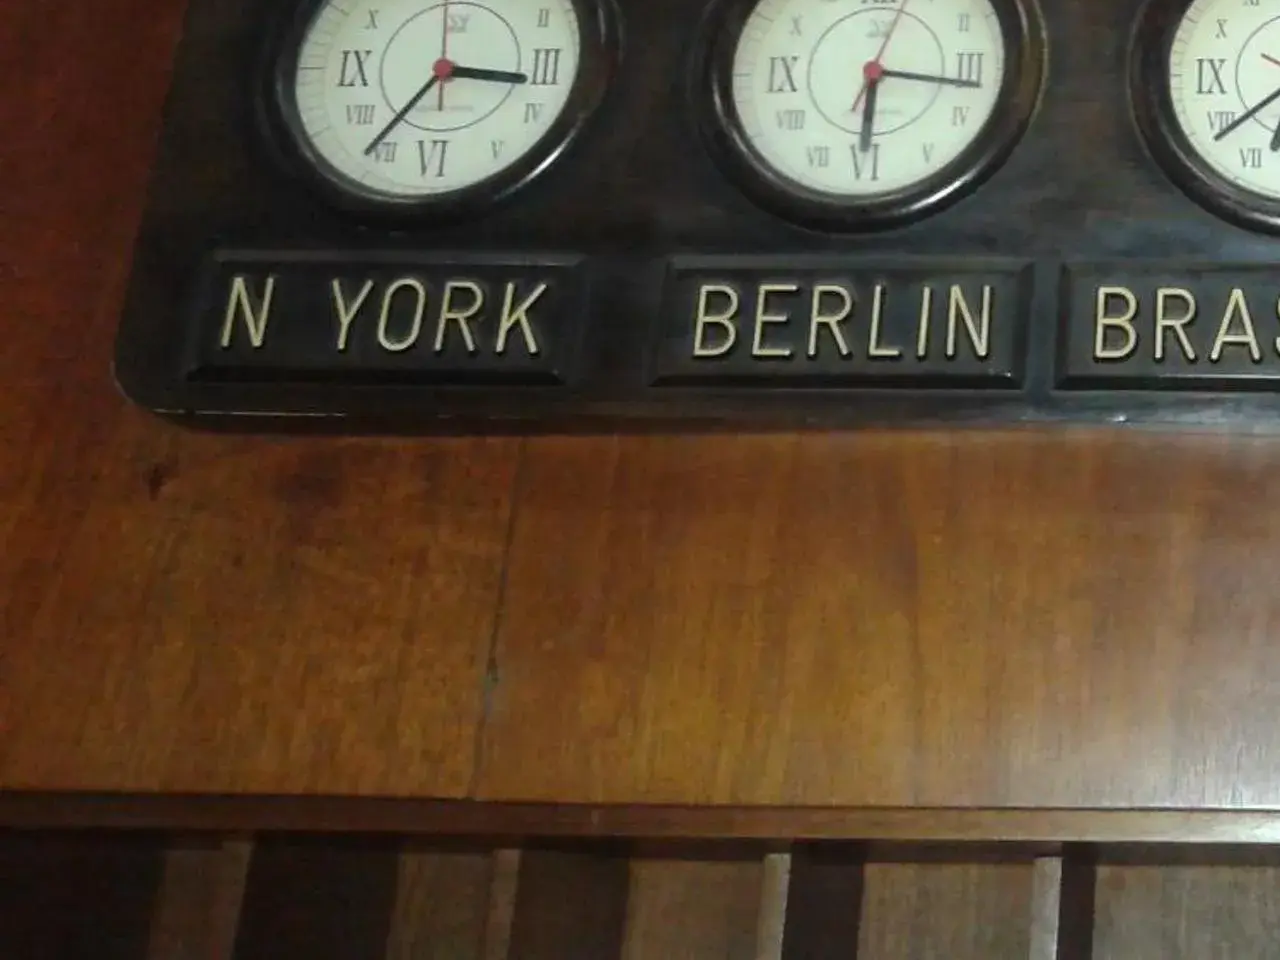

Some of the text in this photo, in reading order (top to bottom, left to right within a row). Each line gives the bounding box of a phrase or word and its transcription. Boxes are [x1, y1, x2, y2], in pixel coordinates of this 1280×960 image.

[338, 50, 372, 87] IX
[530, 48, 563, 85] III
[767, 56, 800, 93] IX
[955, 53, 984, 88] III
[1196, 59, 1227, 94] IX
[416, 140, 448, 177] VI
[222, 276, 547, 354] N YORK
[693, 284, 991, 357] BERLIN
